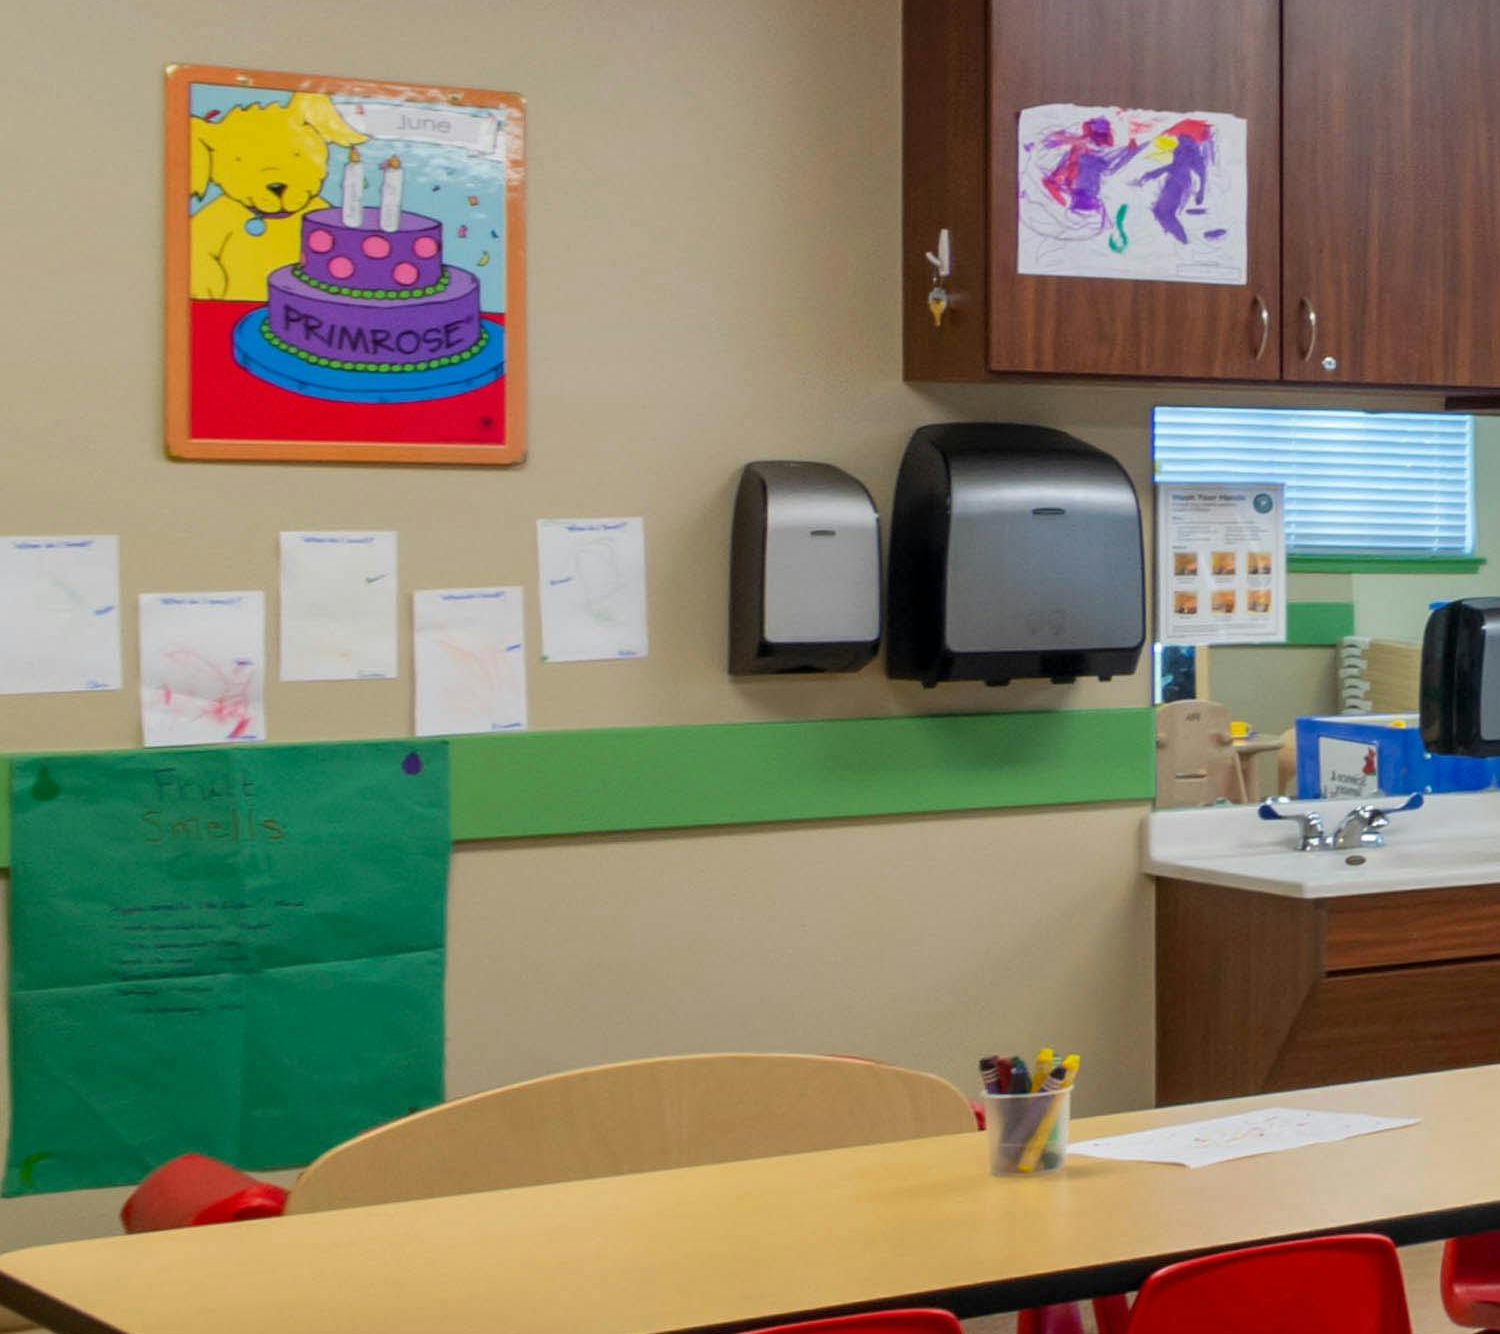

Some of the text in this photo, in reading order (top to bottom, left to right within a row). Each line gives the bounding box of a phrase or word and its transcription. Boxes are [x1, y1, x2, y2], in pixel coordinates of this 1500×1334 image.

[397, 114, 451, 134] June
[282, 304, 467, 356] PRIMROSE
[153, 767, 257, 801] Fruit
[142, 808, 286, 844] Smells
